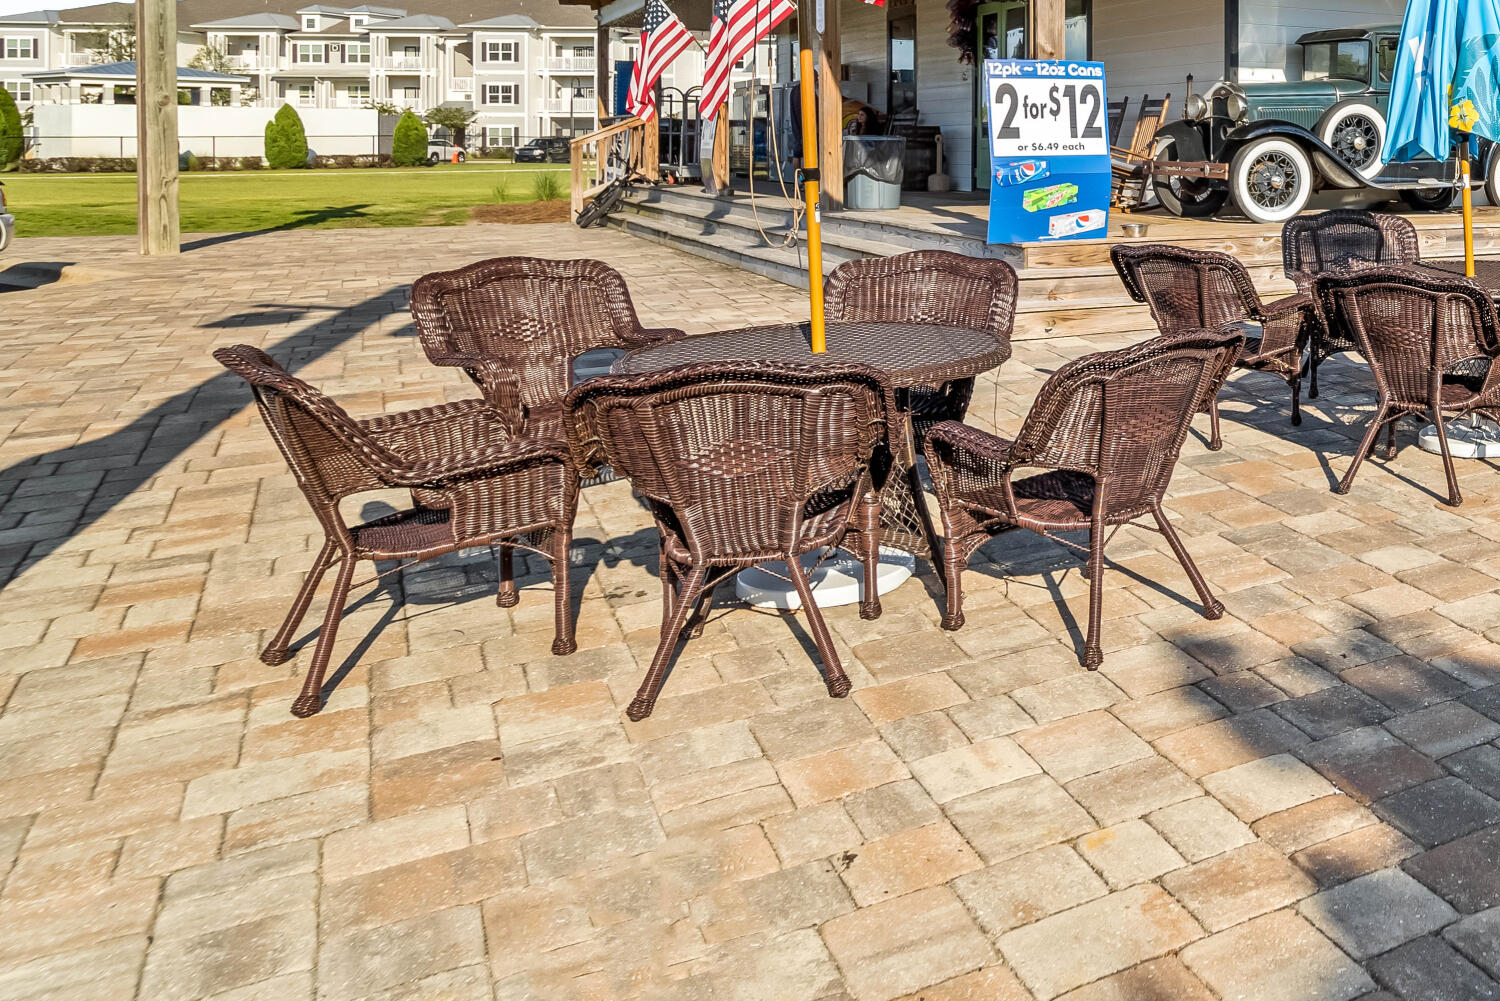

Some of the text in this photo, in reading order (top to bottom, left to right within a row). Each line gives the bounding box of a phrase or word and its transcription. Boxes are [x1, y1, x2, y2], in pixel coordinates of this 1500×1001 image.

[988, 62, 1022, 77] 12pk
[1035, 62, 1065, 76] 12oz
[1068, 63, 1102, 77] Cans
[995, 83, 1102, 139] 2 for $12
[1017, 142, 1085, 152] or $6.49 each
